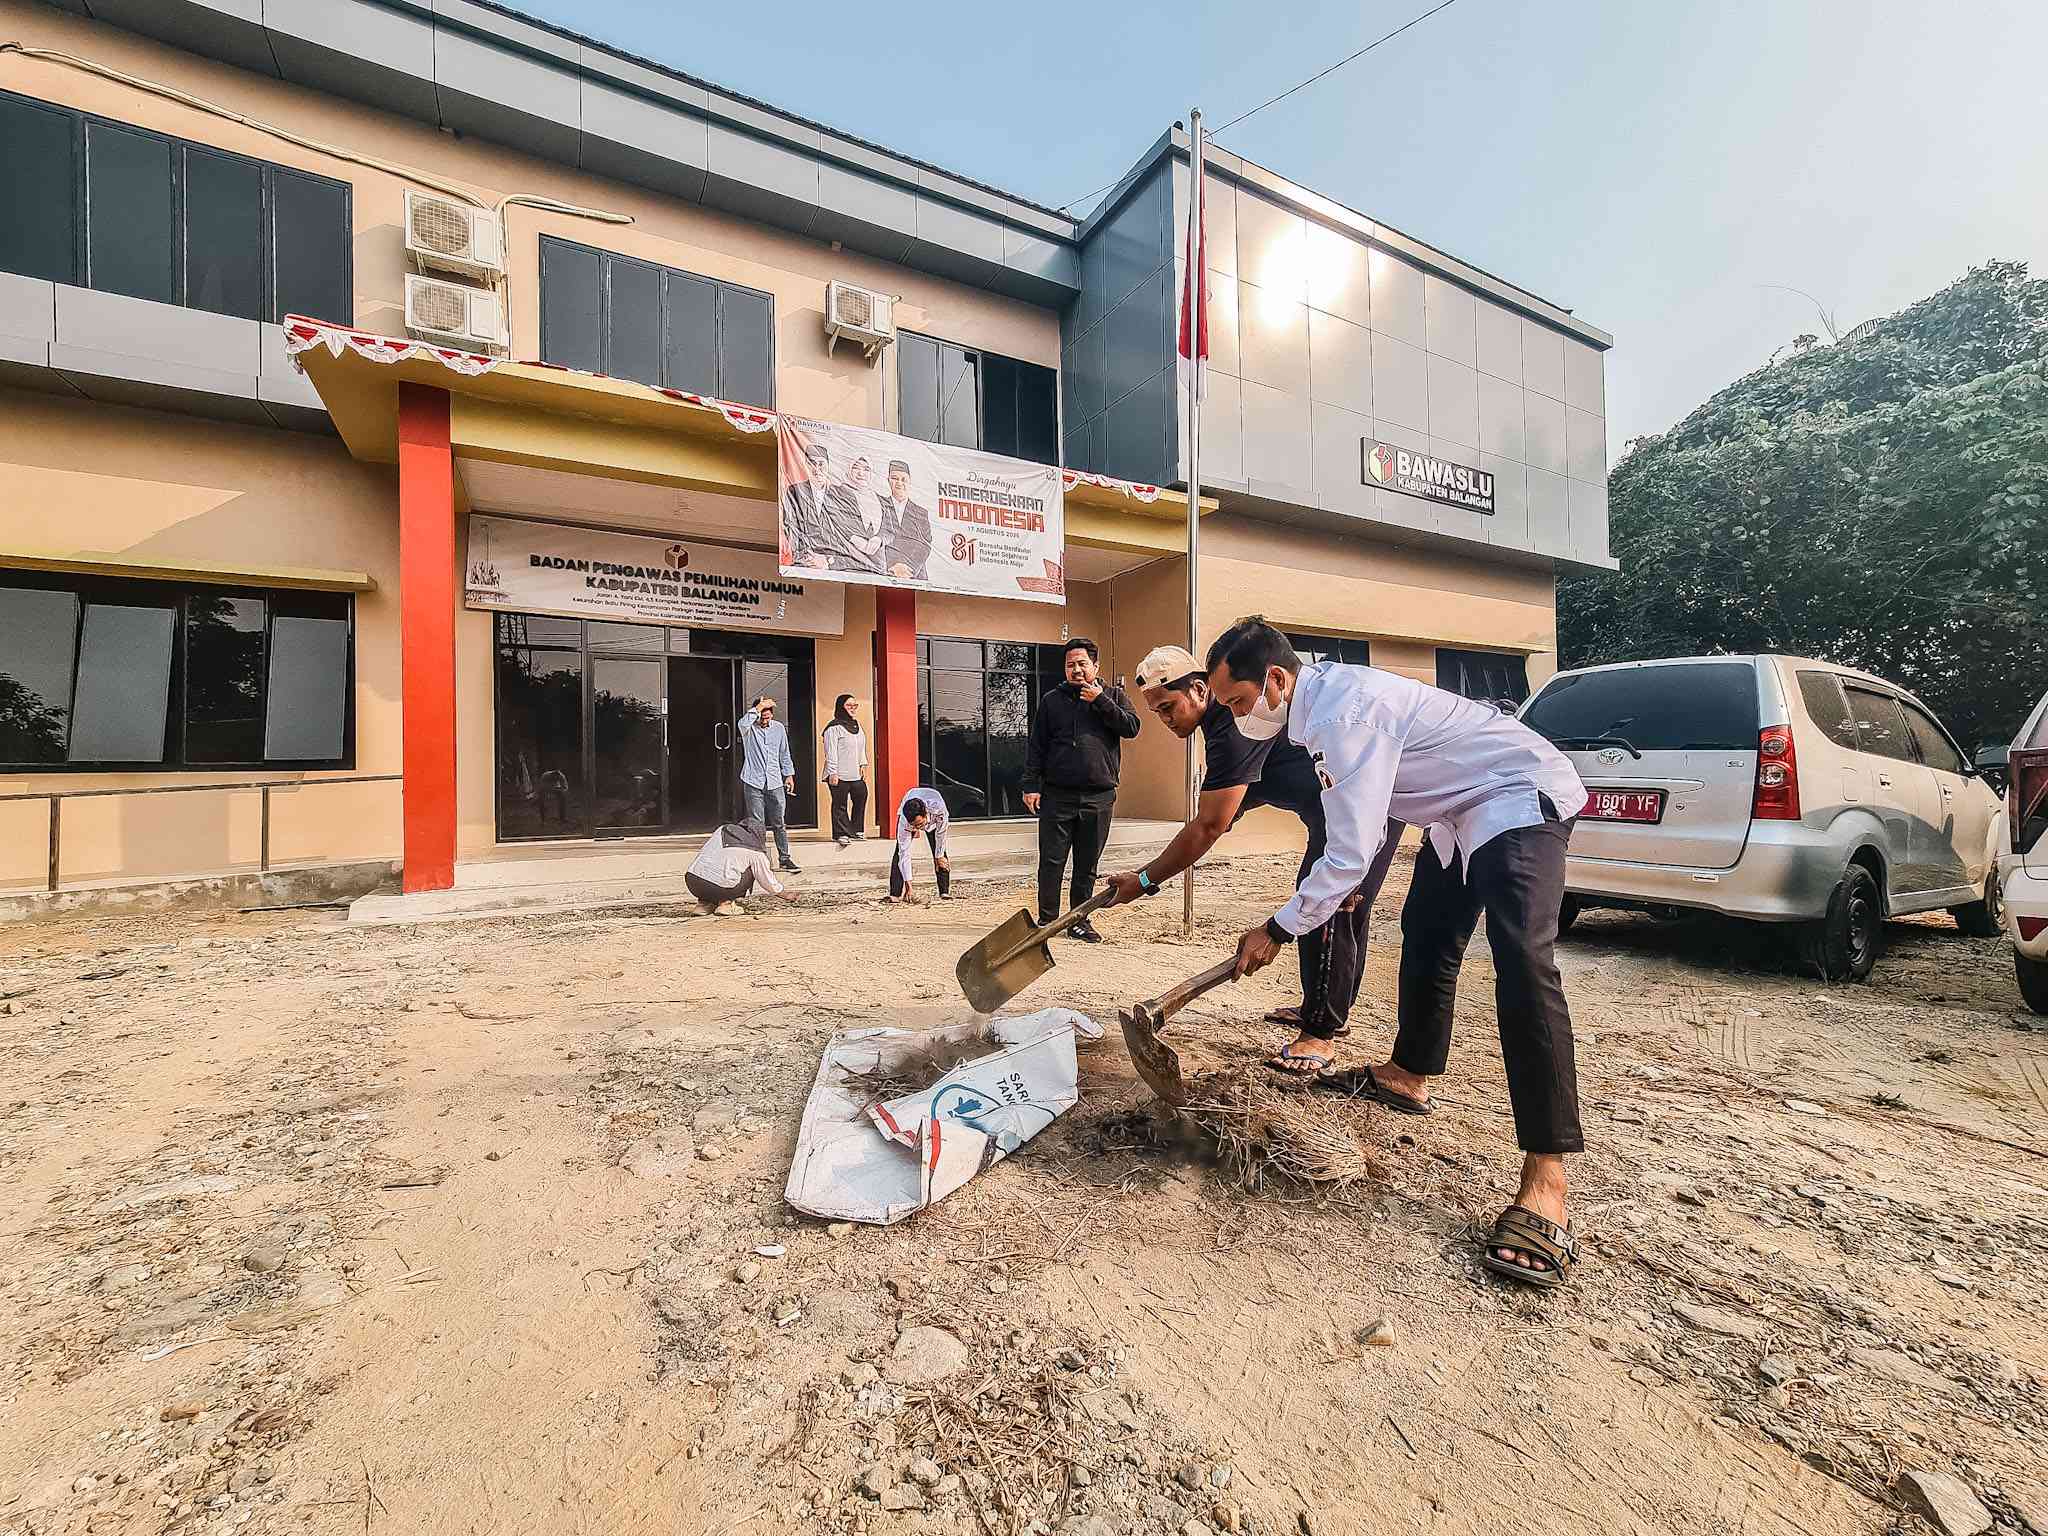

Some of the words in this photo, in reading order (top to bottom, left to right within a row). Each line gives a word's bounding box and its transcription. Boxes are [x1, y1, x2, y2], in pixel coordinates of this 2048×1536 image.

[966, 471, 1017, 493] Dirgahayu
[1397, 451, 1492, 497] BAWASLU
[938, 481, 1044, 512] KEMERDEKAAN
[1397, 476, 1448, 498] KABUPATEN
[1449, 490, 1492, 510] BALANGAN
[938, 498, 1045, 532] INDONESIA
[975, 527, 1005, 537] AGUSTUS
[951, 533, 977, 566] 81
[530, 554, 589, 572] BADAN
[592, 561, 681, 582] PENGAWAS
[684, 572, 758, 591] PEMILIHAN
[761, 581, 804, 595] UMUM
[586, 576, 679, 597] KABUPATEN
[682, 586, 760, 605] BALANGAN
[1596, 794, 1627, 810] 1601
[1637, 795, 1655, 811] YF
[1010, 1072, 1031, 1103] SARI
